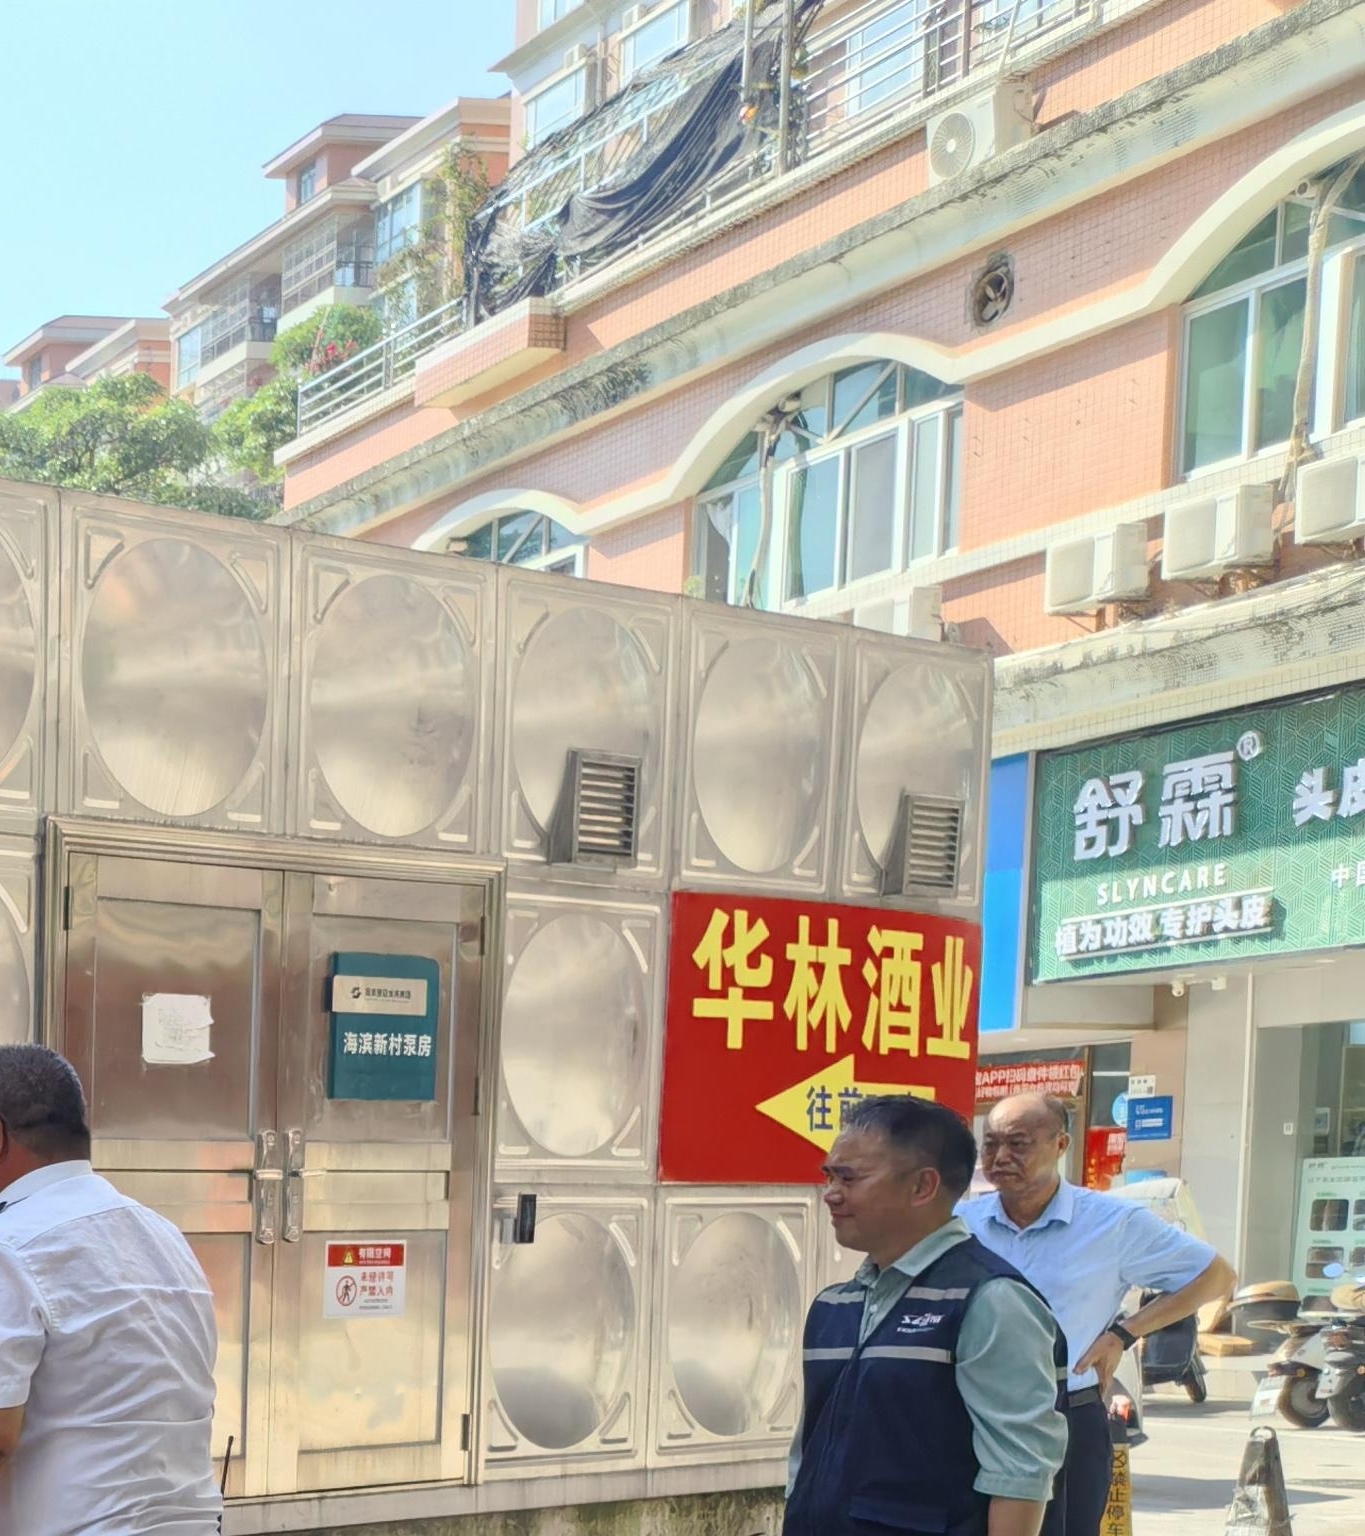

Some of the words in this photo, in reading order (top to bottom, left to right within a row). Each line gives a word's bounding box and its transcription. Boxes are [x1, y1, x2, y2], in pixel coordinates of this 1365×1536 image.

[1096, 862, 1228, 906] SLYNCARE
[691, 907, 974, 1061] 华林酒业
[343, 1031, 432, 1057] 海滨新村泵房
